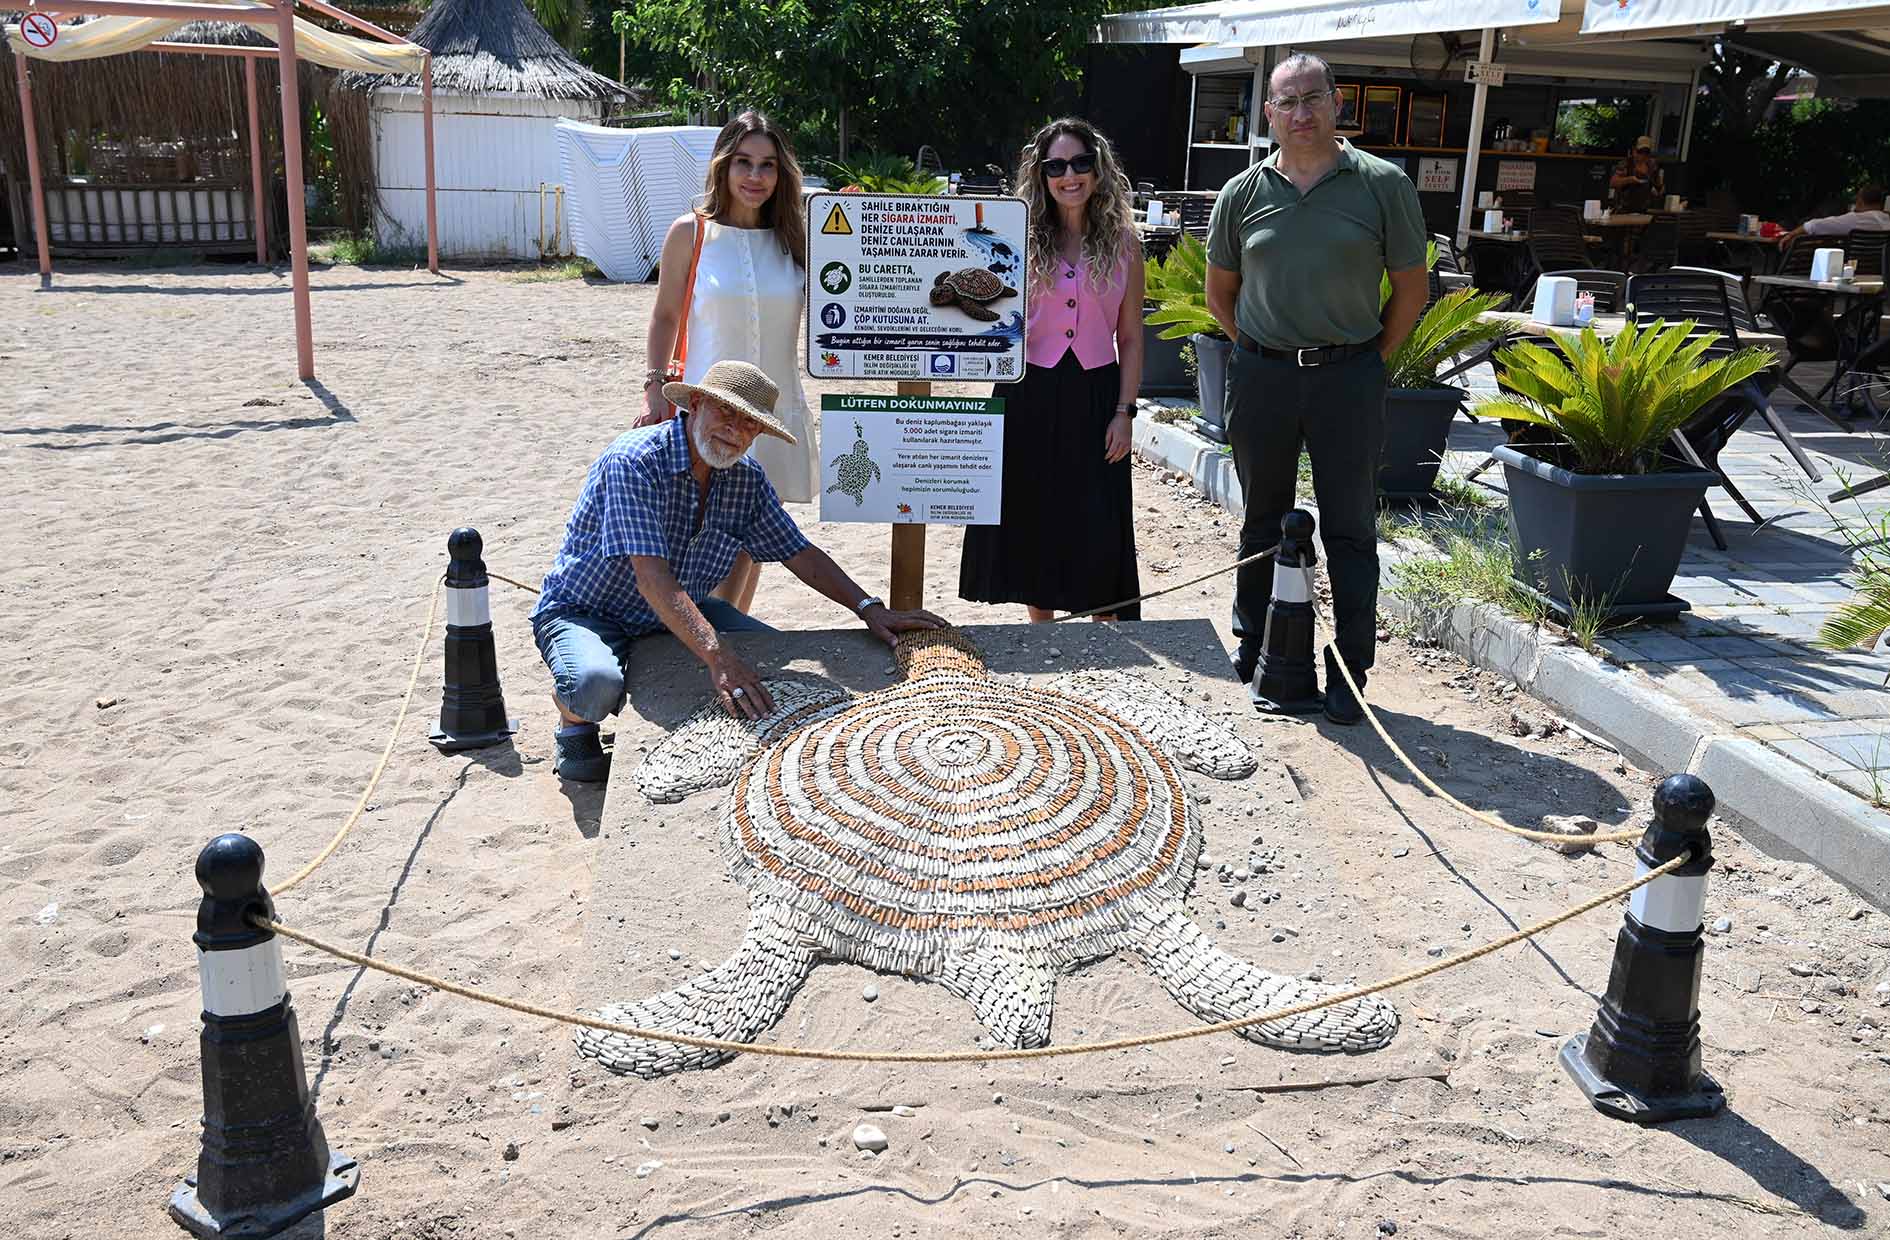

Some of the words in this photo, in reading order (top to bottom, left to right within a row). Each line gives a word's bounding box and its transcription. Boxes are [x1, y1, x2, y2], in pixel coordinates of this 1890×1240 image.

[861, 200, 893, 211] SAHİLE
[896, 202, 950, 213] BIRAKTIĞIN
[861, 213, 879, 222] HER
[881, 212, 914, 223] SİGARA
[861, 223, 893, 234] DENİZE
[896, 226, 944, 236] ULAŞARAK
[861, 235, 888, 245] DENİZ
[890, 237, 954, 247] CANLILARININ
[861, 247, 907, 258] YAŞAMINA
[909, 248, 938, 258] ZARAR
[941, 247, 969, 258] VERİR.
[859, 264, 871, 273] BU
[873, 264, 916, 275] CARETTA,
[888, 306, 911, 314] DOĞAYA
[854, 314, 870, 324] ÇÖP
[873, 315, 915, 324] KUTUSUNA
[917, 316, 929, 324] AT.
[831, 336, 850, 346] Bugün
[852, 337, 871, 346] attığın
[873, 337, 882, 345] bir
[907, 339, 923, 347] yarın
[942, 338, 966, 348] sağlığını
[864, 353, 884, 361] KEMER
[886, 353, 920, 361] BELEDİYESİ
[841, 397, 887, 409] LÜTFEN
[890, 399, 986, 411] DOKUNMAYINIZ
[924, 418, 966, 427] kaplumbağası
[968, 419, 992, 427] yaklaşık
